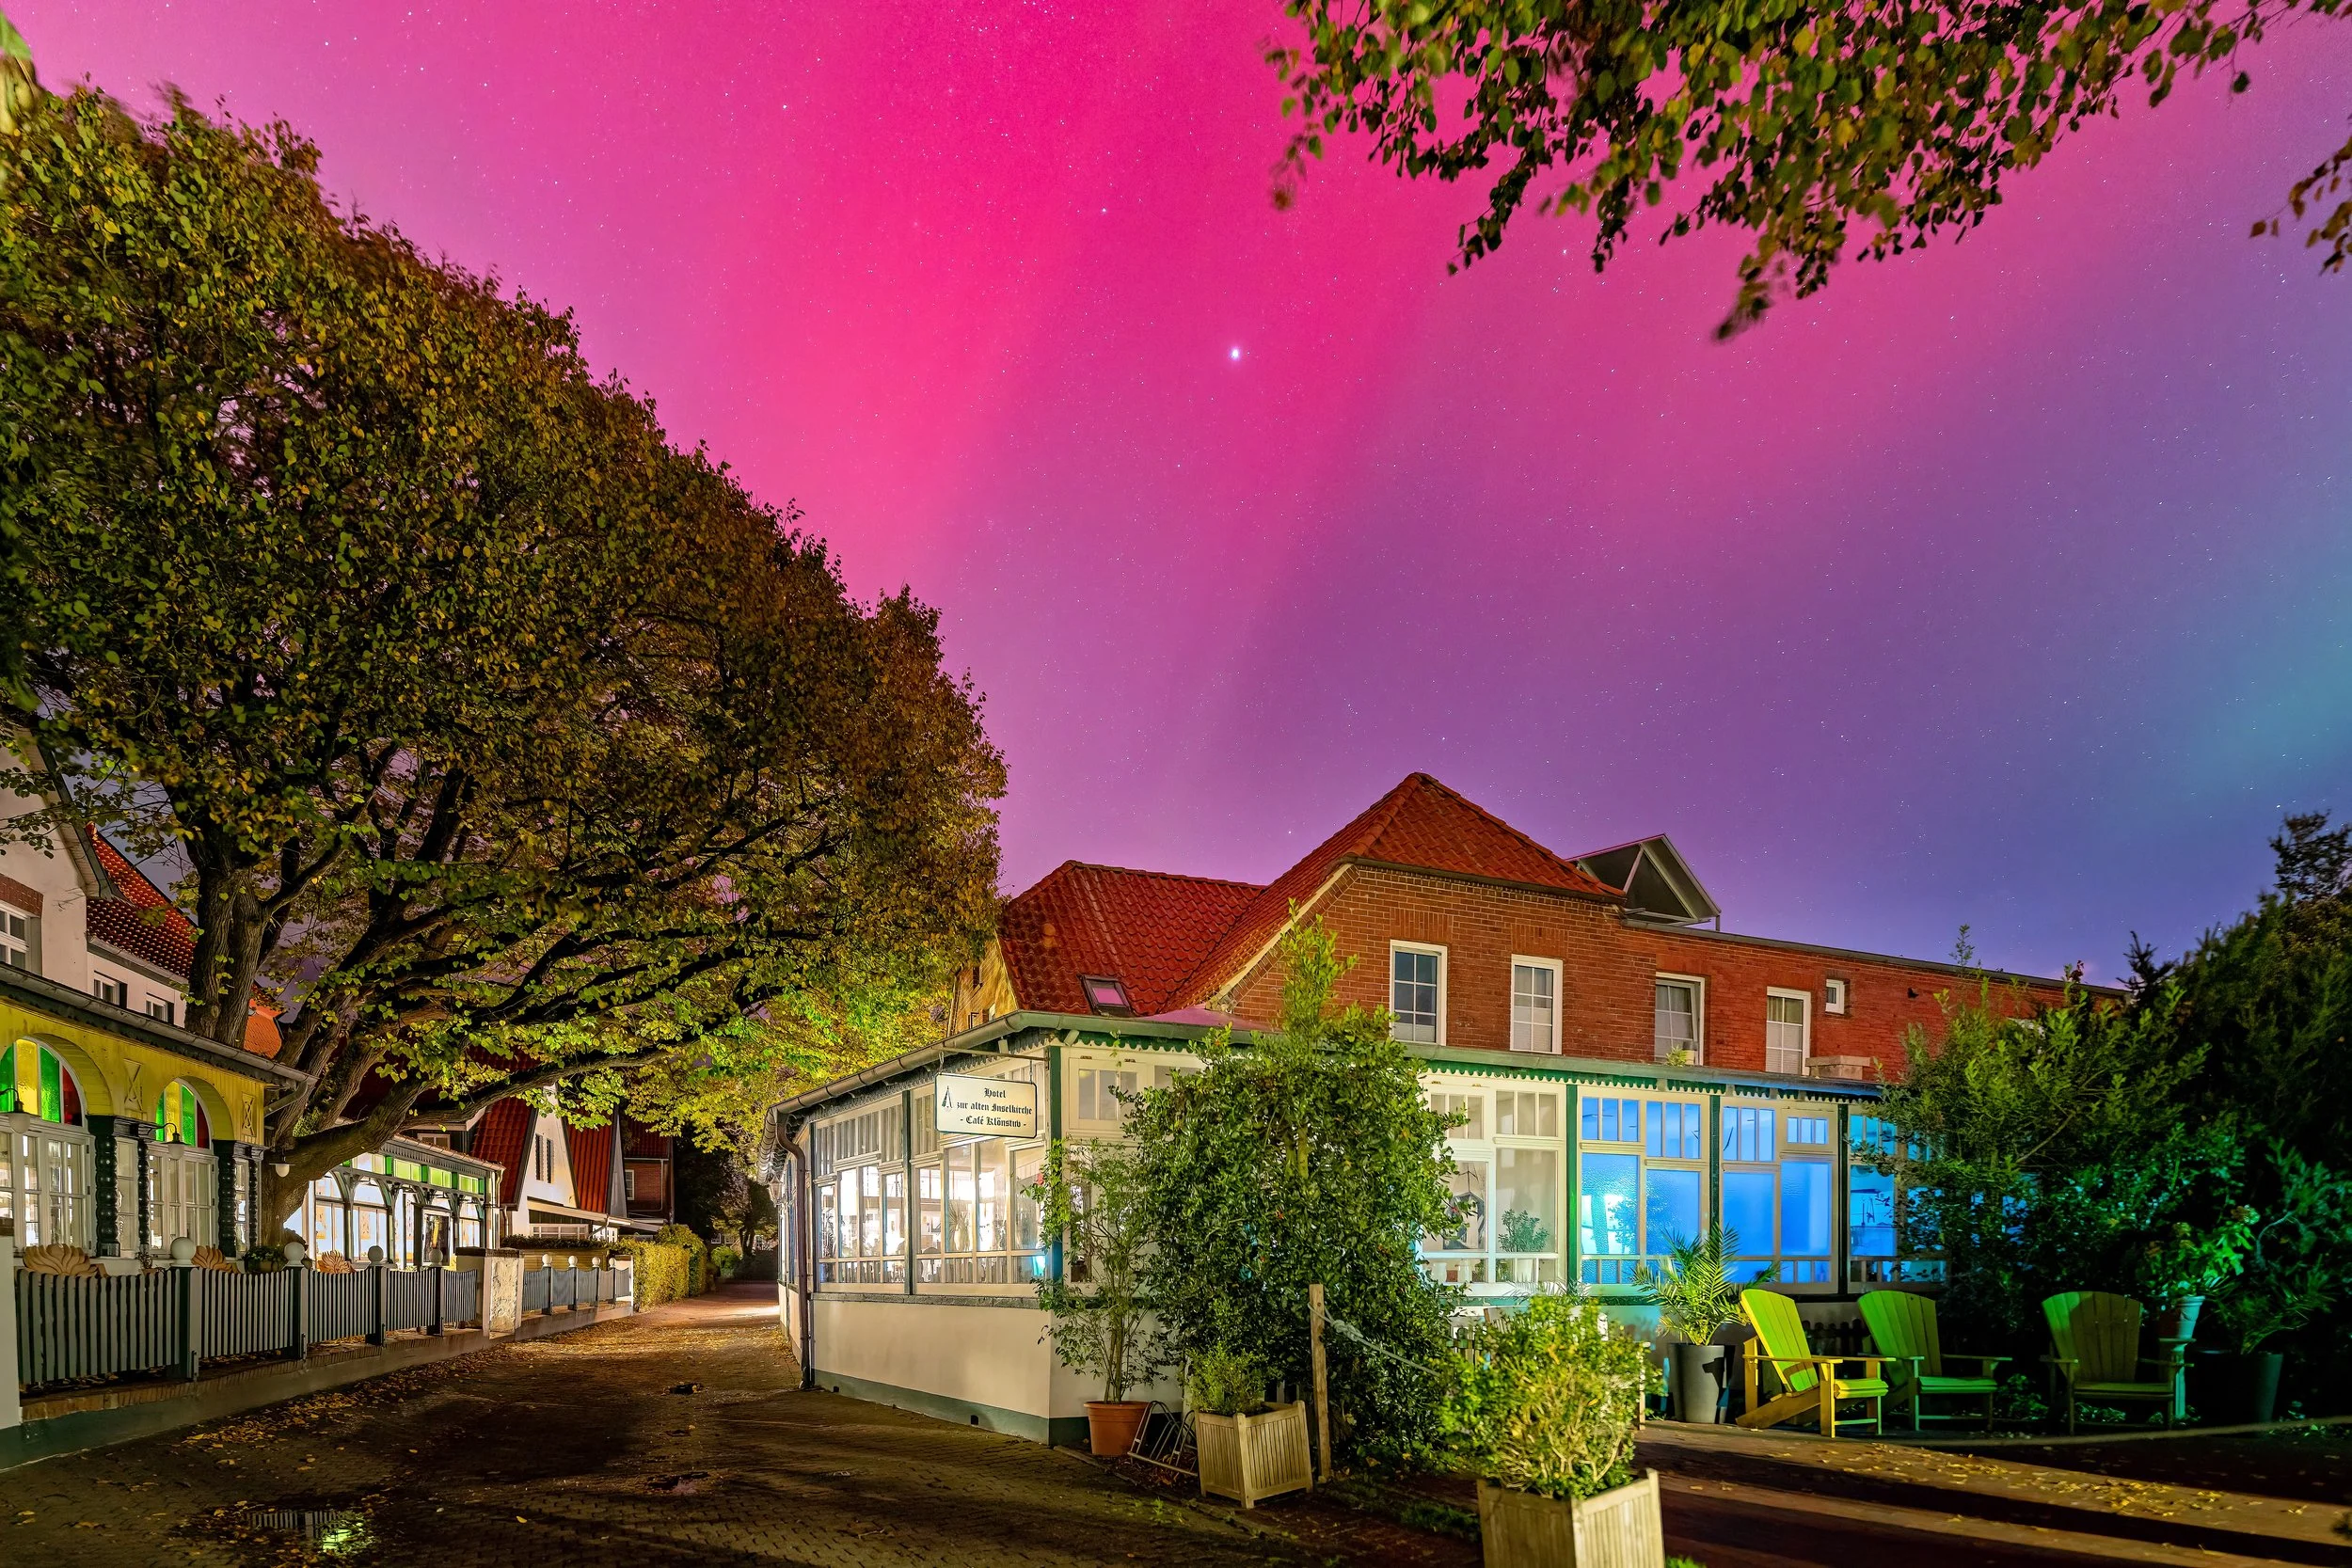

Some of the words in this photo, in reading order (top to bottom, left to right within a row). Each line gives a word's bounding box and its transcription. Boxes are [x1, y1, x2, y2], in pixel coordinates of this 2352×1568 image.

[984, 1087, 1006, 1098] Hotel
[970, 1101, 989, 1111] alten
[991, 1103, 1032, 1115] Inselkirche
[965, 1115, 984, 1125] Café
